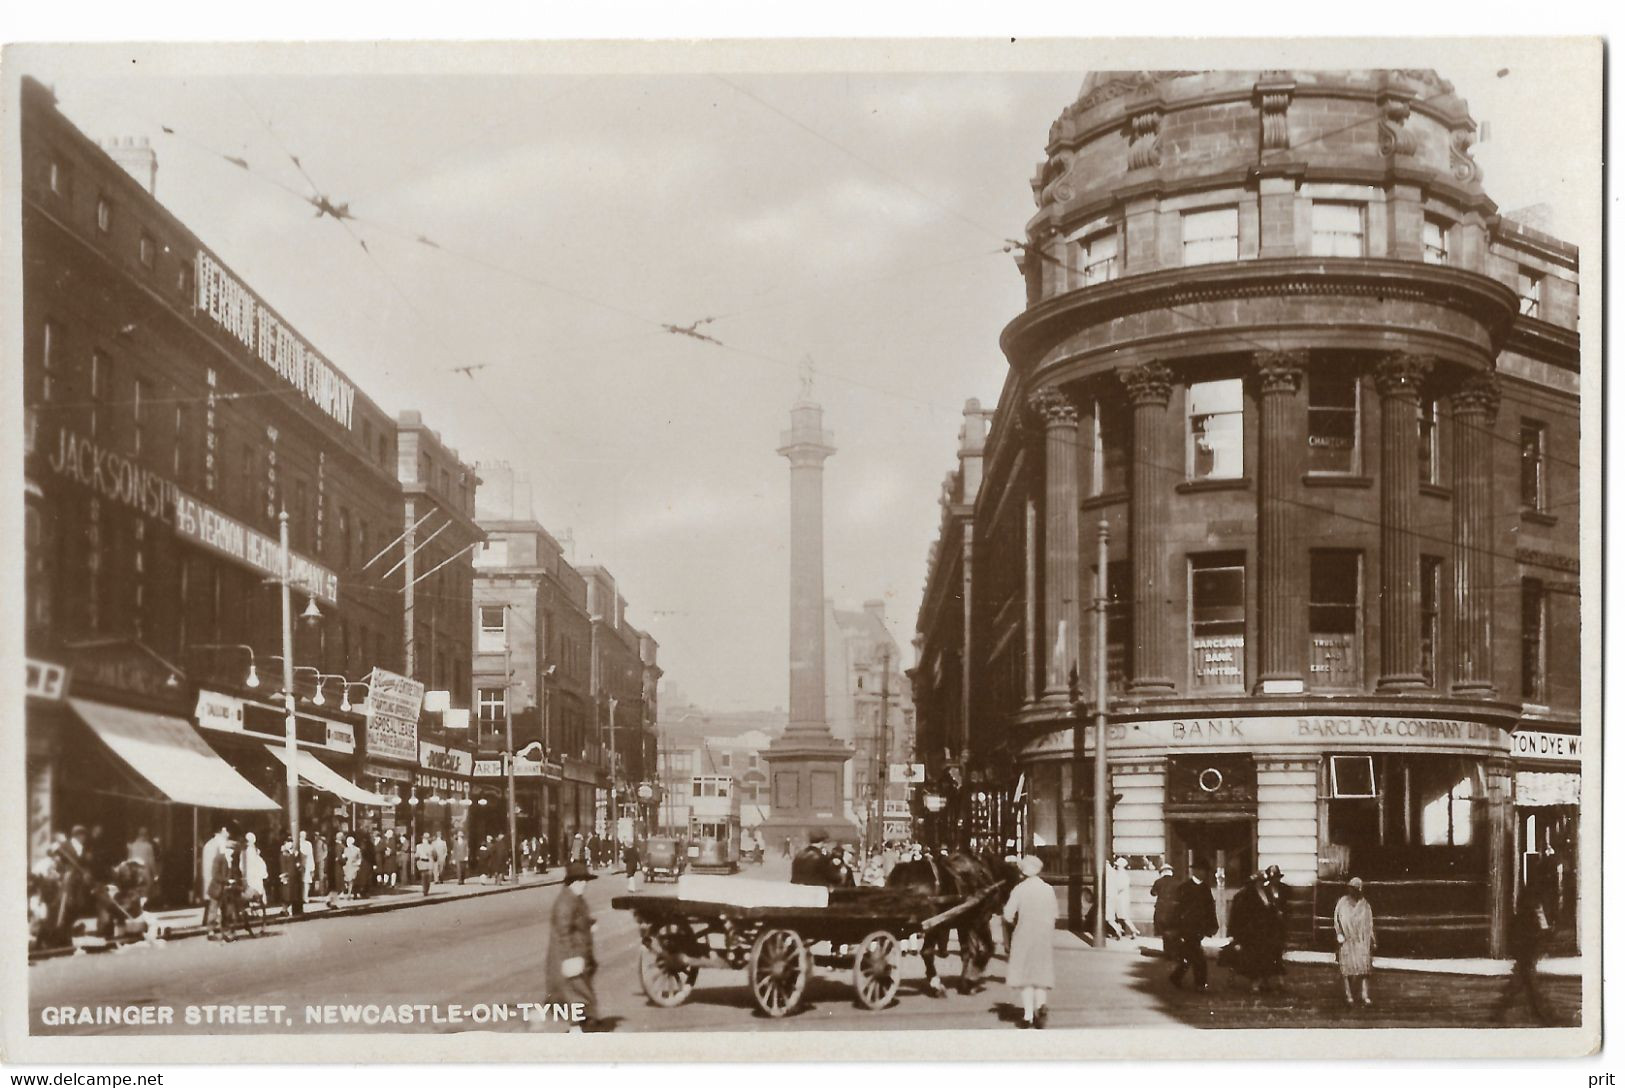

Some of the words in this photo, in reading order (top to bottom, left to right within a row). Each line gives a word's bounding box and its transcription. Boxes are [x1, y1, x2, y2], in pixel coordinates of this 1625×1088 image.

[197, 250, 256, 351] VERNON
[307, 350, 354, 430] COMPANY
[49, 427, 159, 518] JACKSONS
[198, 506, 244, 559] VERNON
[1193, 637, 1244, 649] BARCLAYS
[1205, 652, 1233, 662] BANK
[1172, 720, 1245, 740] BANK
[1396, 719, 1463, 740] COMPANY
[1541, 735, 1563, 755] DYE
